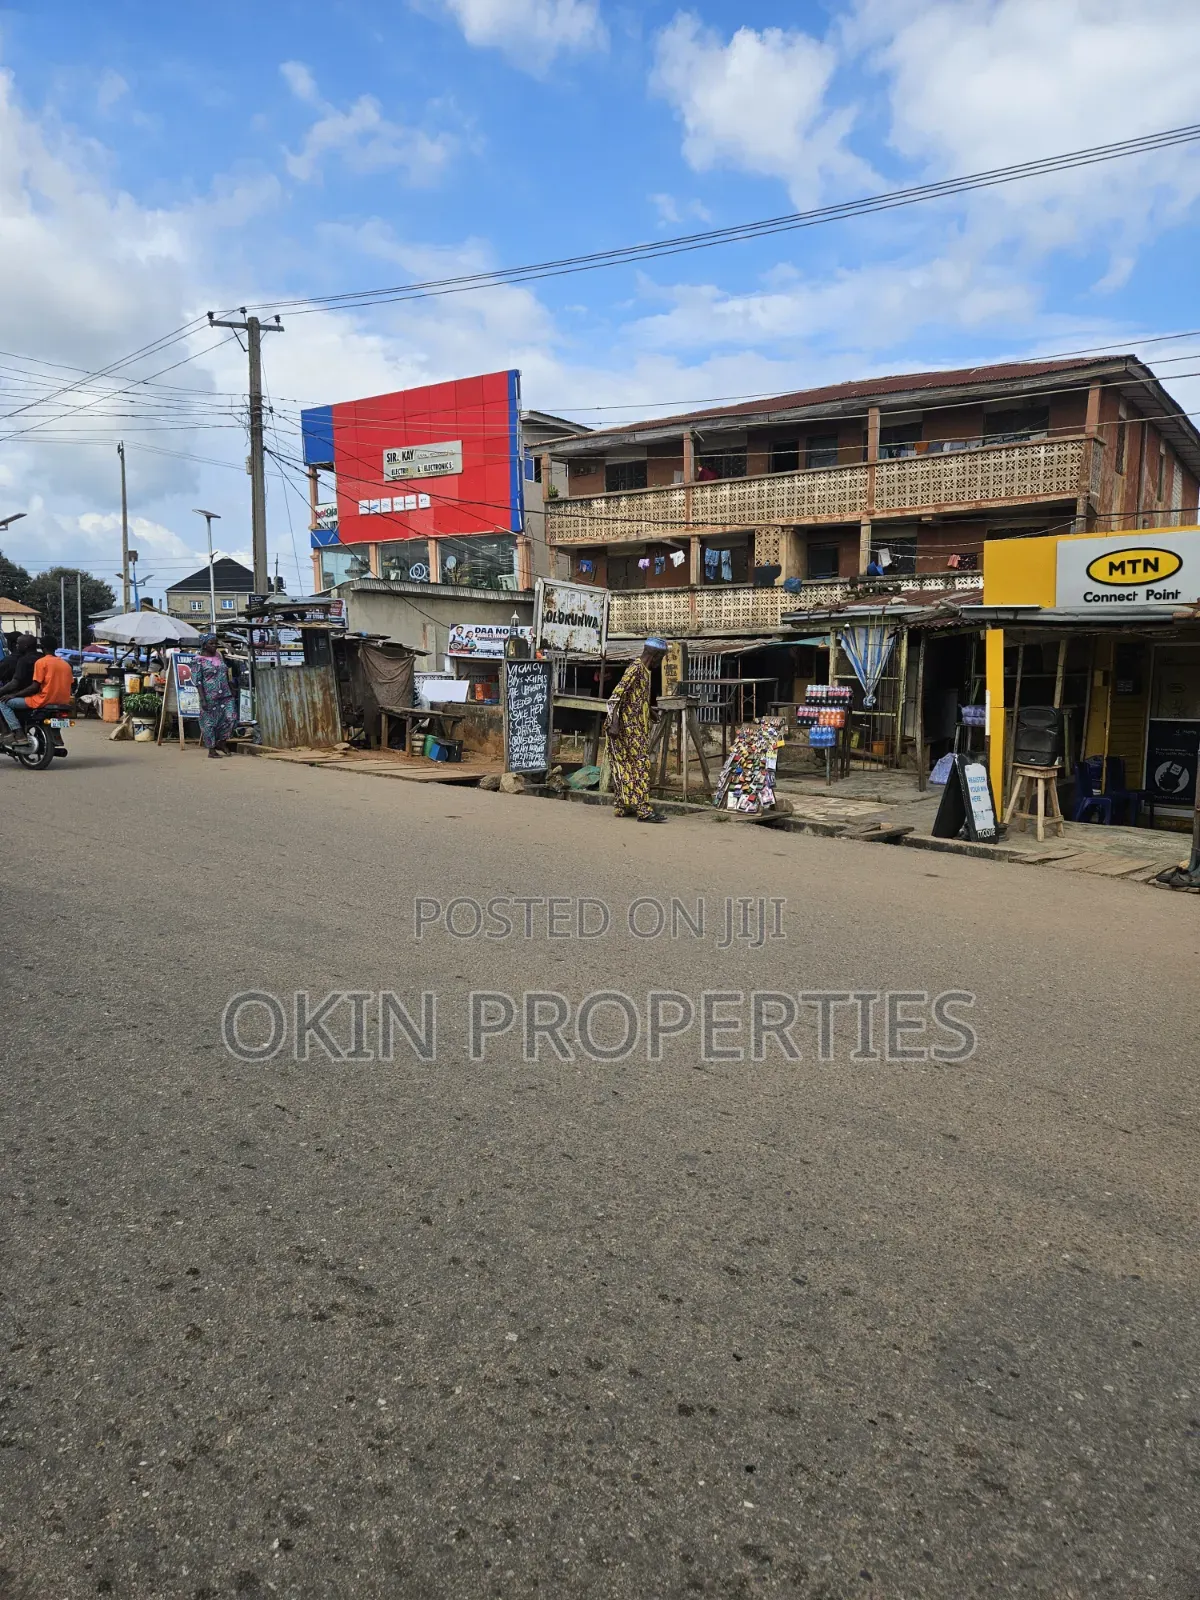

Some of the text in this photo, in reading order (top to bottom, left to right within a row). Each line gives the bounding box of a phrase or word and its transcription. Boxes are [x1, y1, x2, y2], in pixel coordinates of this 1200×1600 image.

[401, 449, 415, 461] KAY
[1108, 557, 1159, 576] MTN
[1083, 589, 1181, 602] Connect Point
